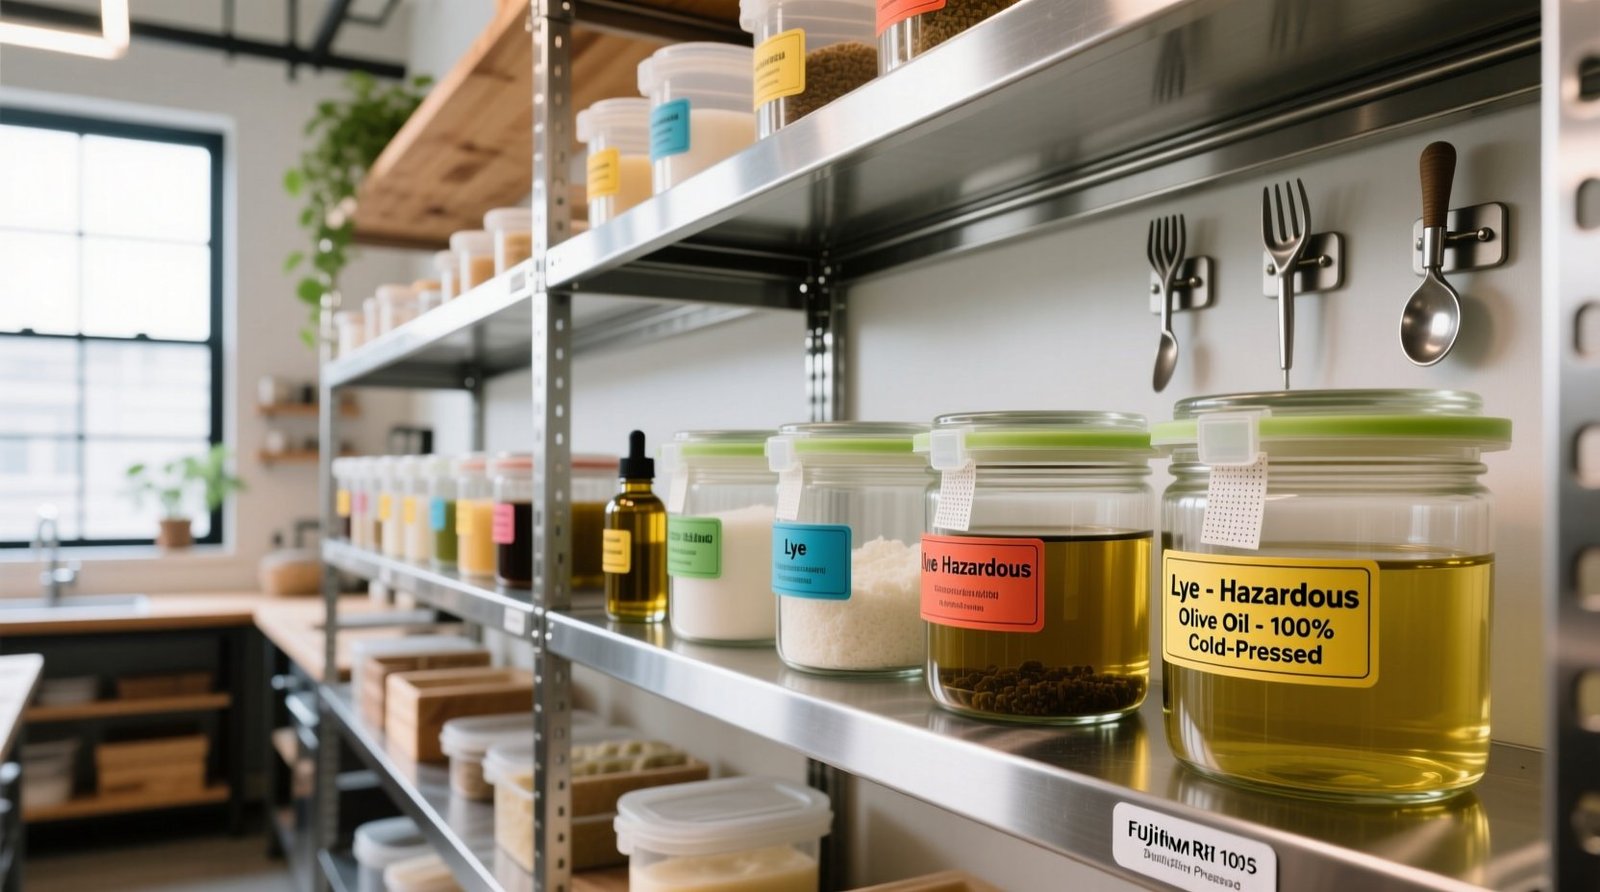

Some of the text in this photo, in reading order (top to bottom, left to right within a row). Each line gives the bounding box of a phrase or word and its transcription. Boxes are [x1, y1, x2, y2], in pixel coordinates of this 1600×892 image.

[785, 538, 807, 560] Lye
[942, 555, 1032, 578] Hazardous
[1171, 574, 1200, 603] Lye
[1220, 578, 1360, 609] Hazardous
[1179, 607, 1217, 630] Olive
[1223, 613, 1249, 633] Oil
[1271, 616, 1335, 640] 100%
[1189, 633, 1322, 665] Cold-Pressed
